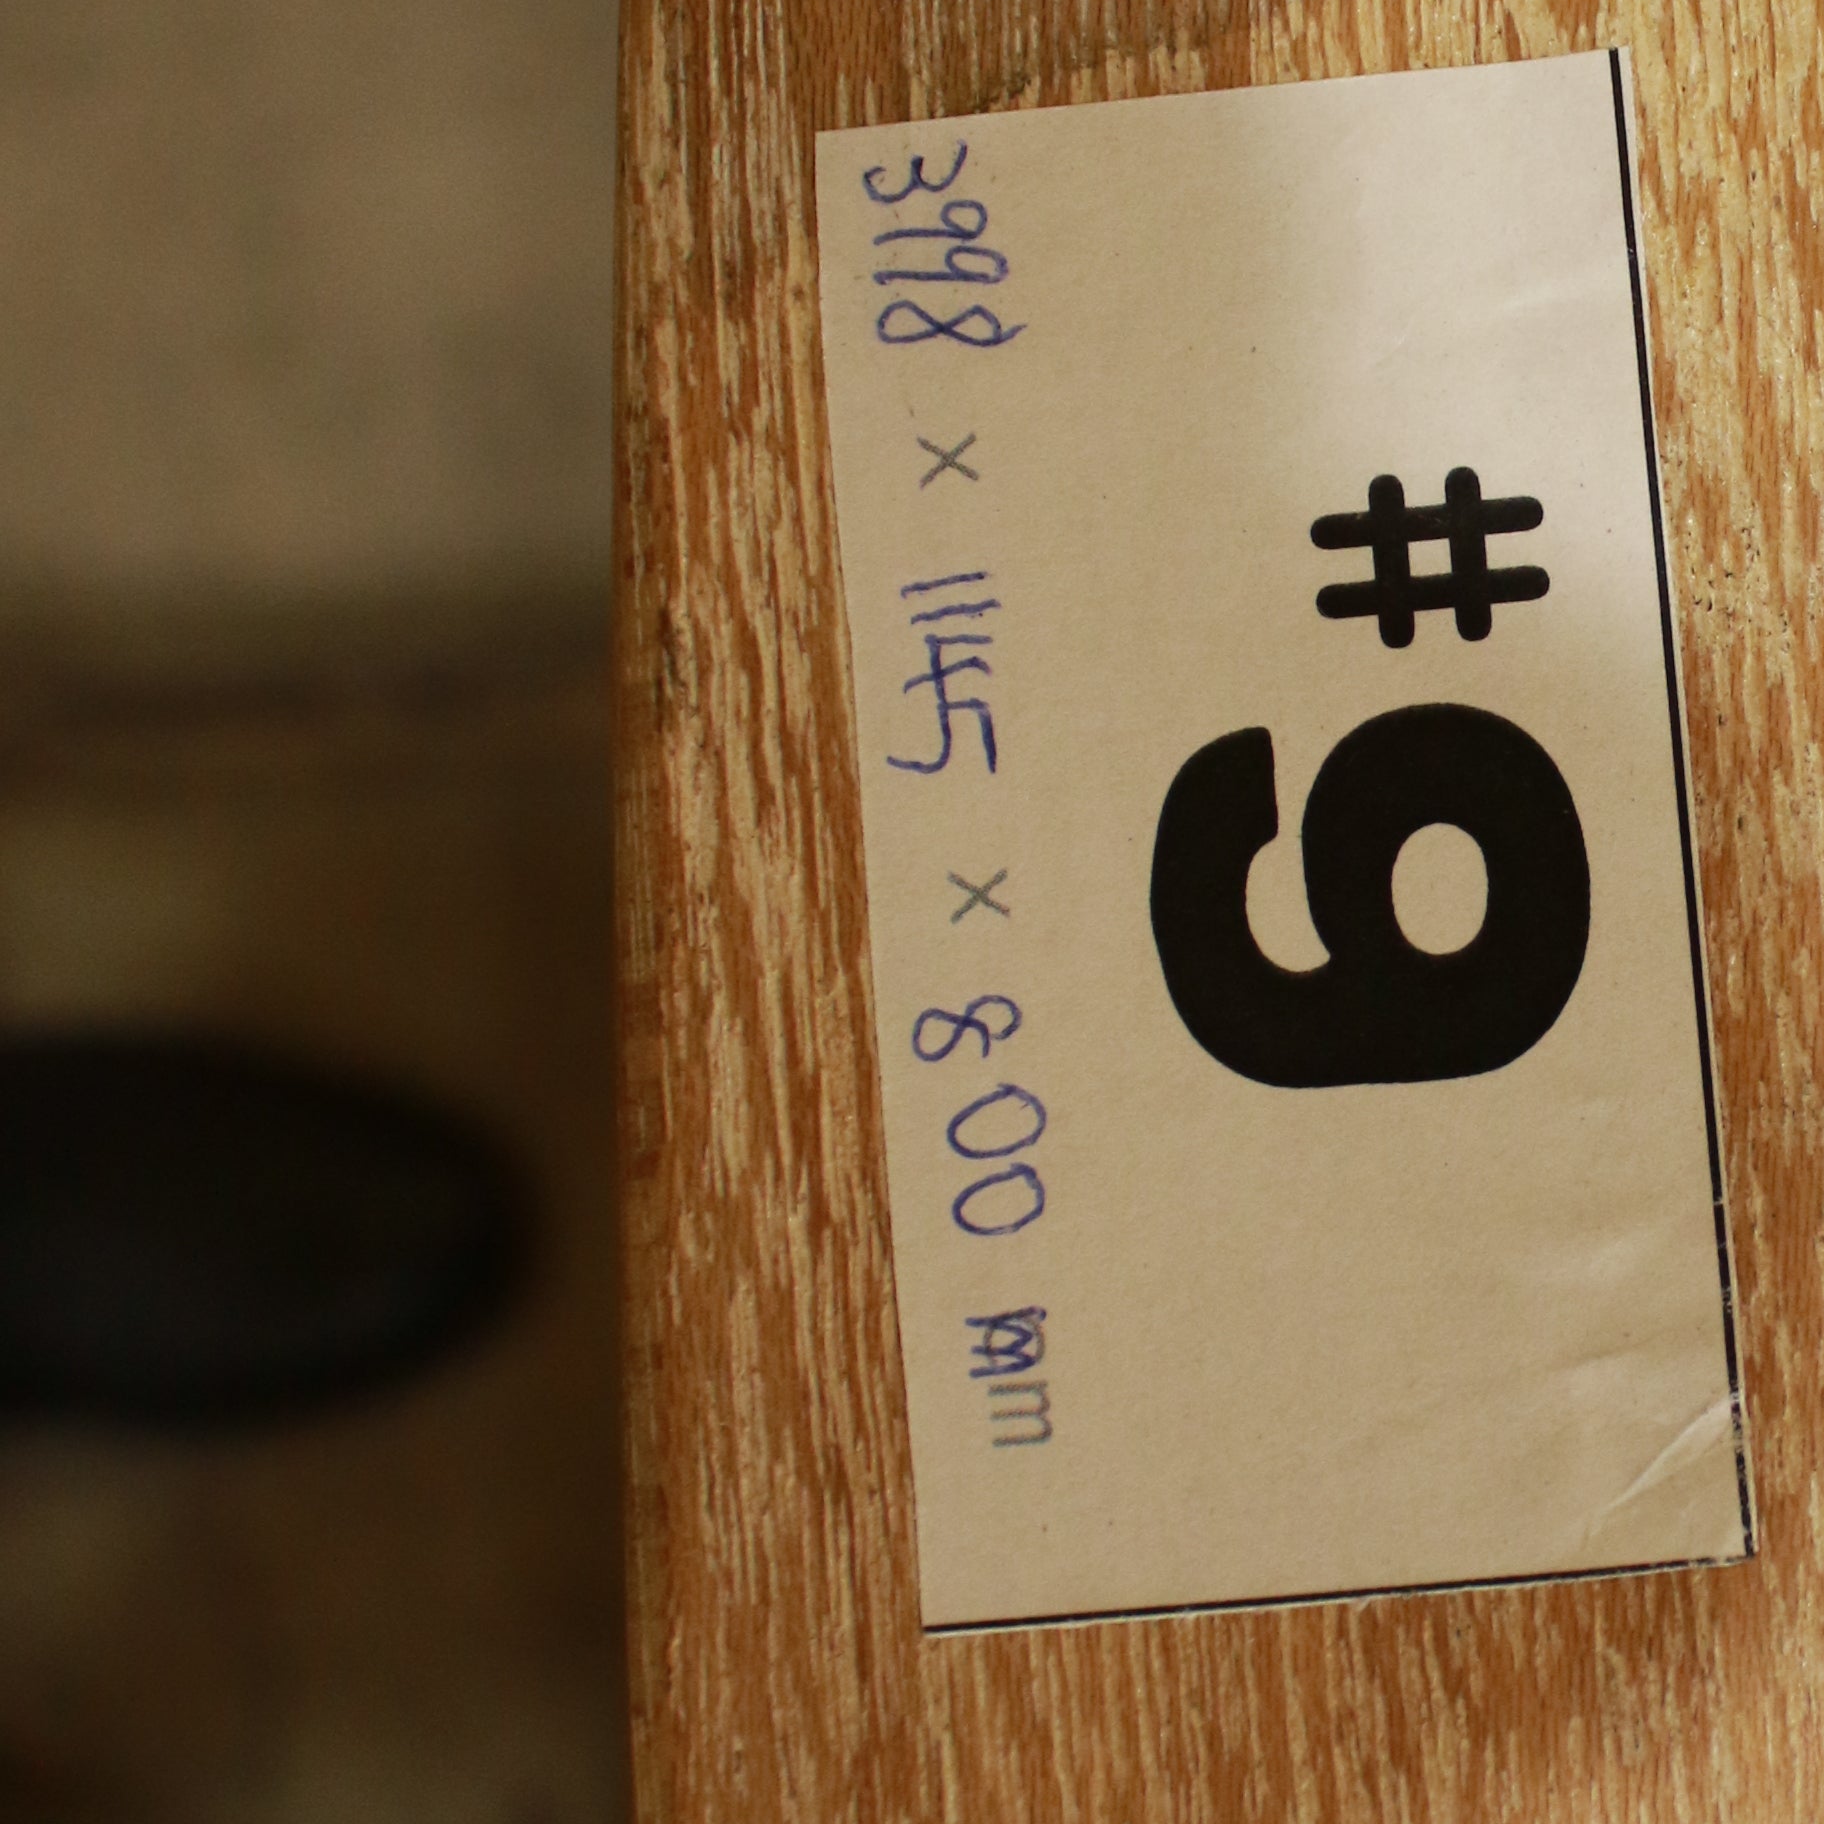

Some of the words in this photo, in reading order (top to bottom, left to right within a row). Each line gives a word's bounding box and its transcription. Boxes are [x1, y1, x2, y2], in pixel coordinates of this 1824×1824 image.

[861, 141, 1025, 351] 3998
[887, 569, 1004, 776] 1145
[910, 993, 1048, 1238] 800
[964, 1305, 1055, 1450] mm
